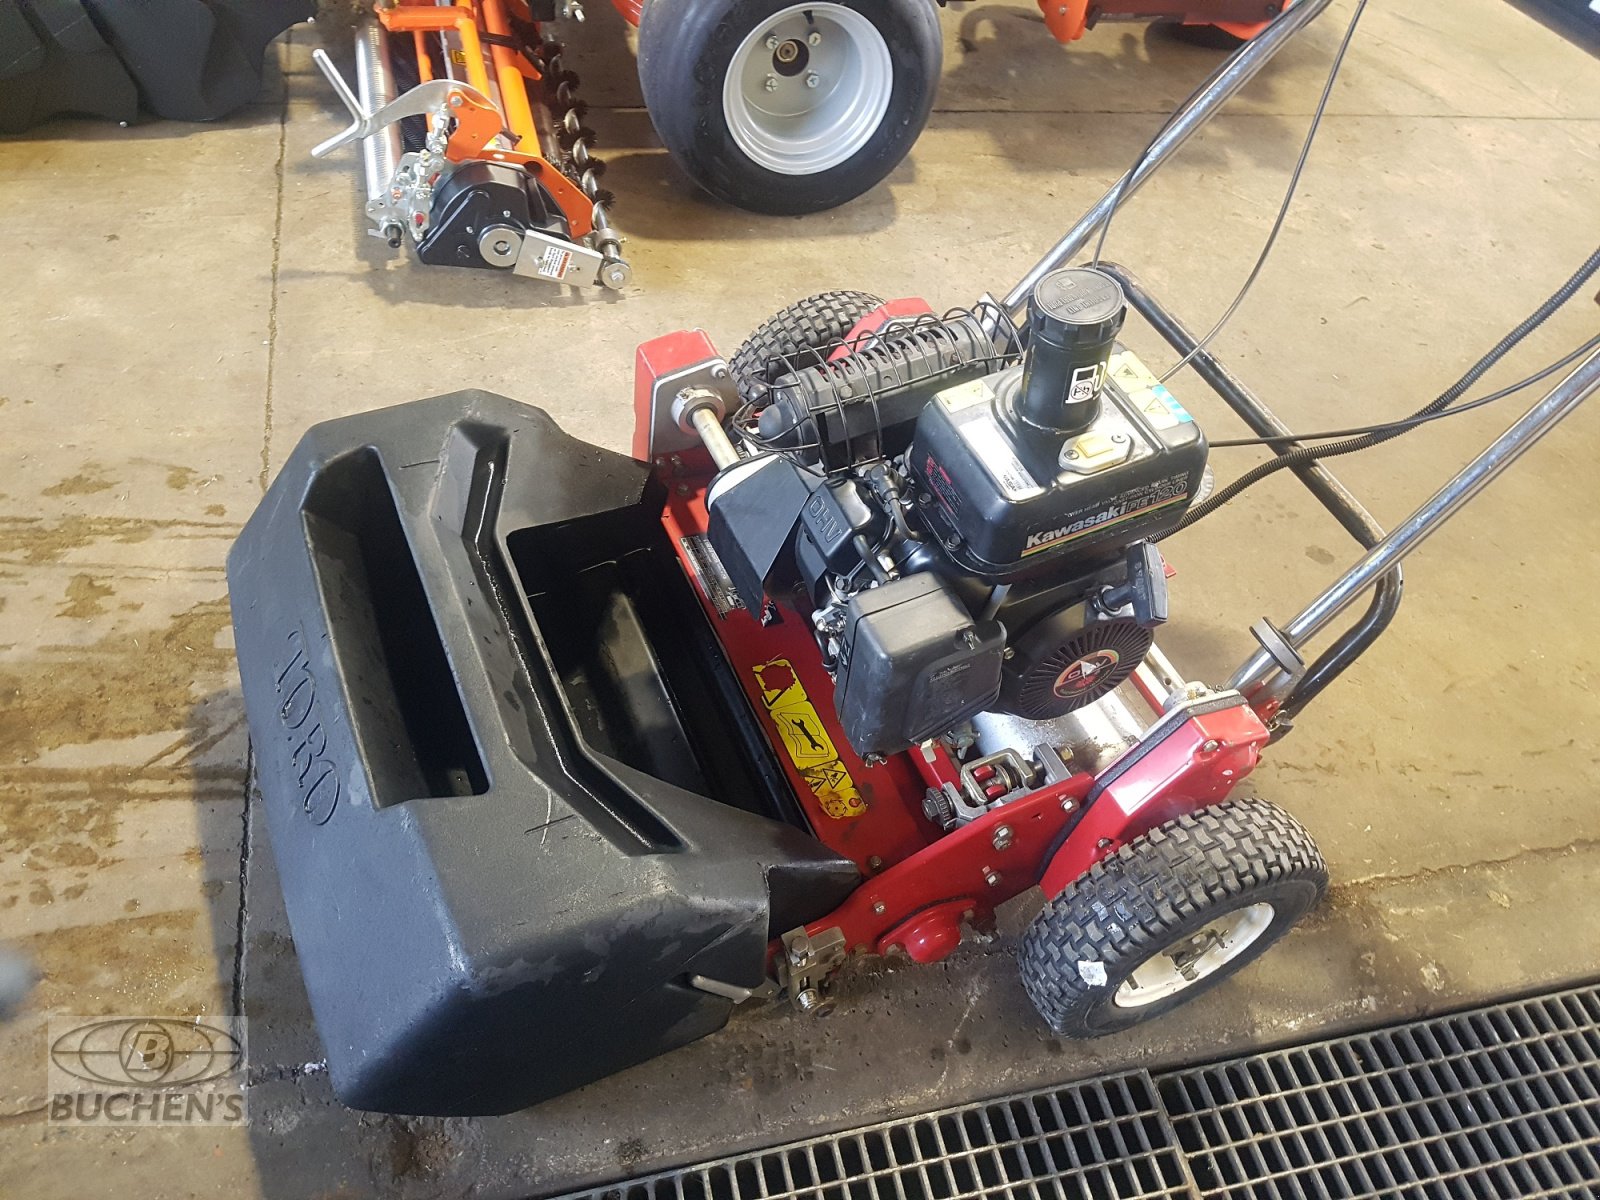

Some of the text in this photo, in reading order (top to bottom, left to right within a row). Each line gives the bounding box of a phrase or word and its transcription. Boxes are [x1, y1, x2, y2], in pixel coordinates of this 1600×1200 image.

[809, 495, 842, 544] OHV
[1026, 501, 1126, 549] Kawasaki
[274, 629, 341, 827] TORO
